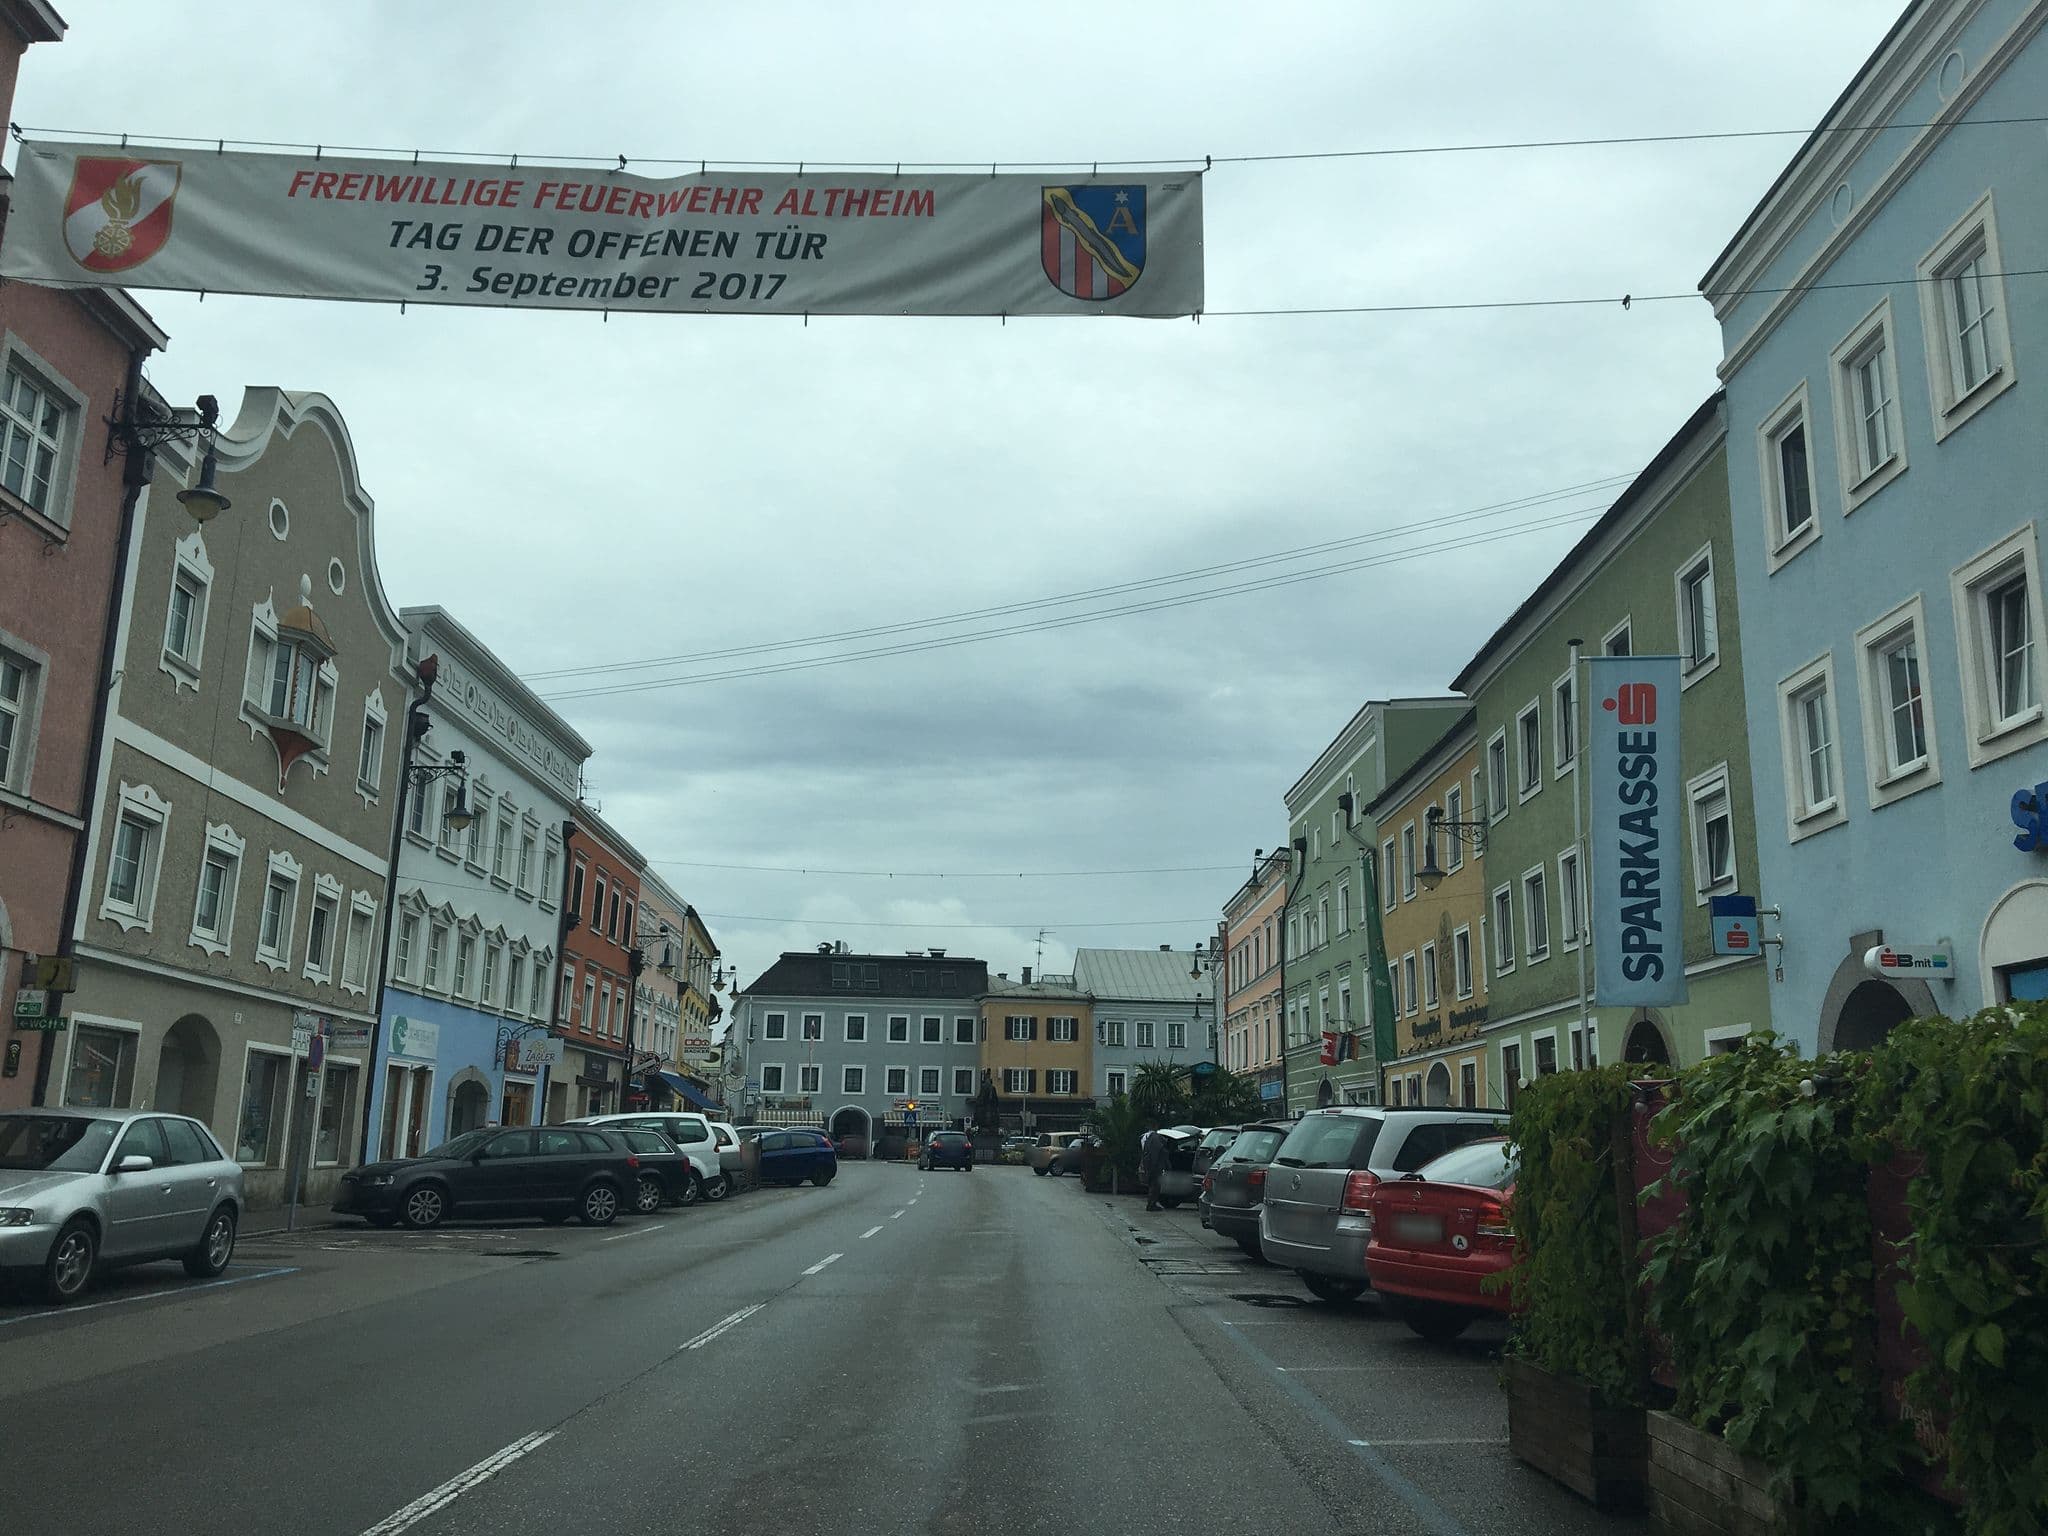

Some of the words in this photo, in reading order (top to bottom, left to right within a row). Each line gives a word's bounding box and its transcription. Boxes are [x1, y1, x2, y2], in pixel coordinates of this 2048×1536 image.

[288, 170, 525, 208] FREIWILLIGE
[533, 182, 764, 219] FEUERWEHR
[773, 188, 936, 218] ALTHEIM
[390, 220, 464, 251] TAG
[474, 223, 555, 256] DER
[567, 228, 741, 261] OFFENEN
[755, 224, 828, 261] TÜR
[416, 264, 449, 292] 3.
[466, 266, 680, 300] September
[690, 271, 788, 301] 2017
[1617, 731, 1665, 983] SPARKASSE
[1914, 957, 1932, 968] mit
[1456, 1237, 1465, 1248] A
